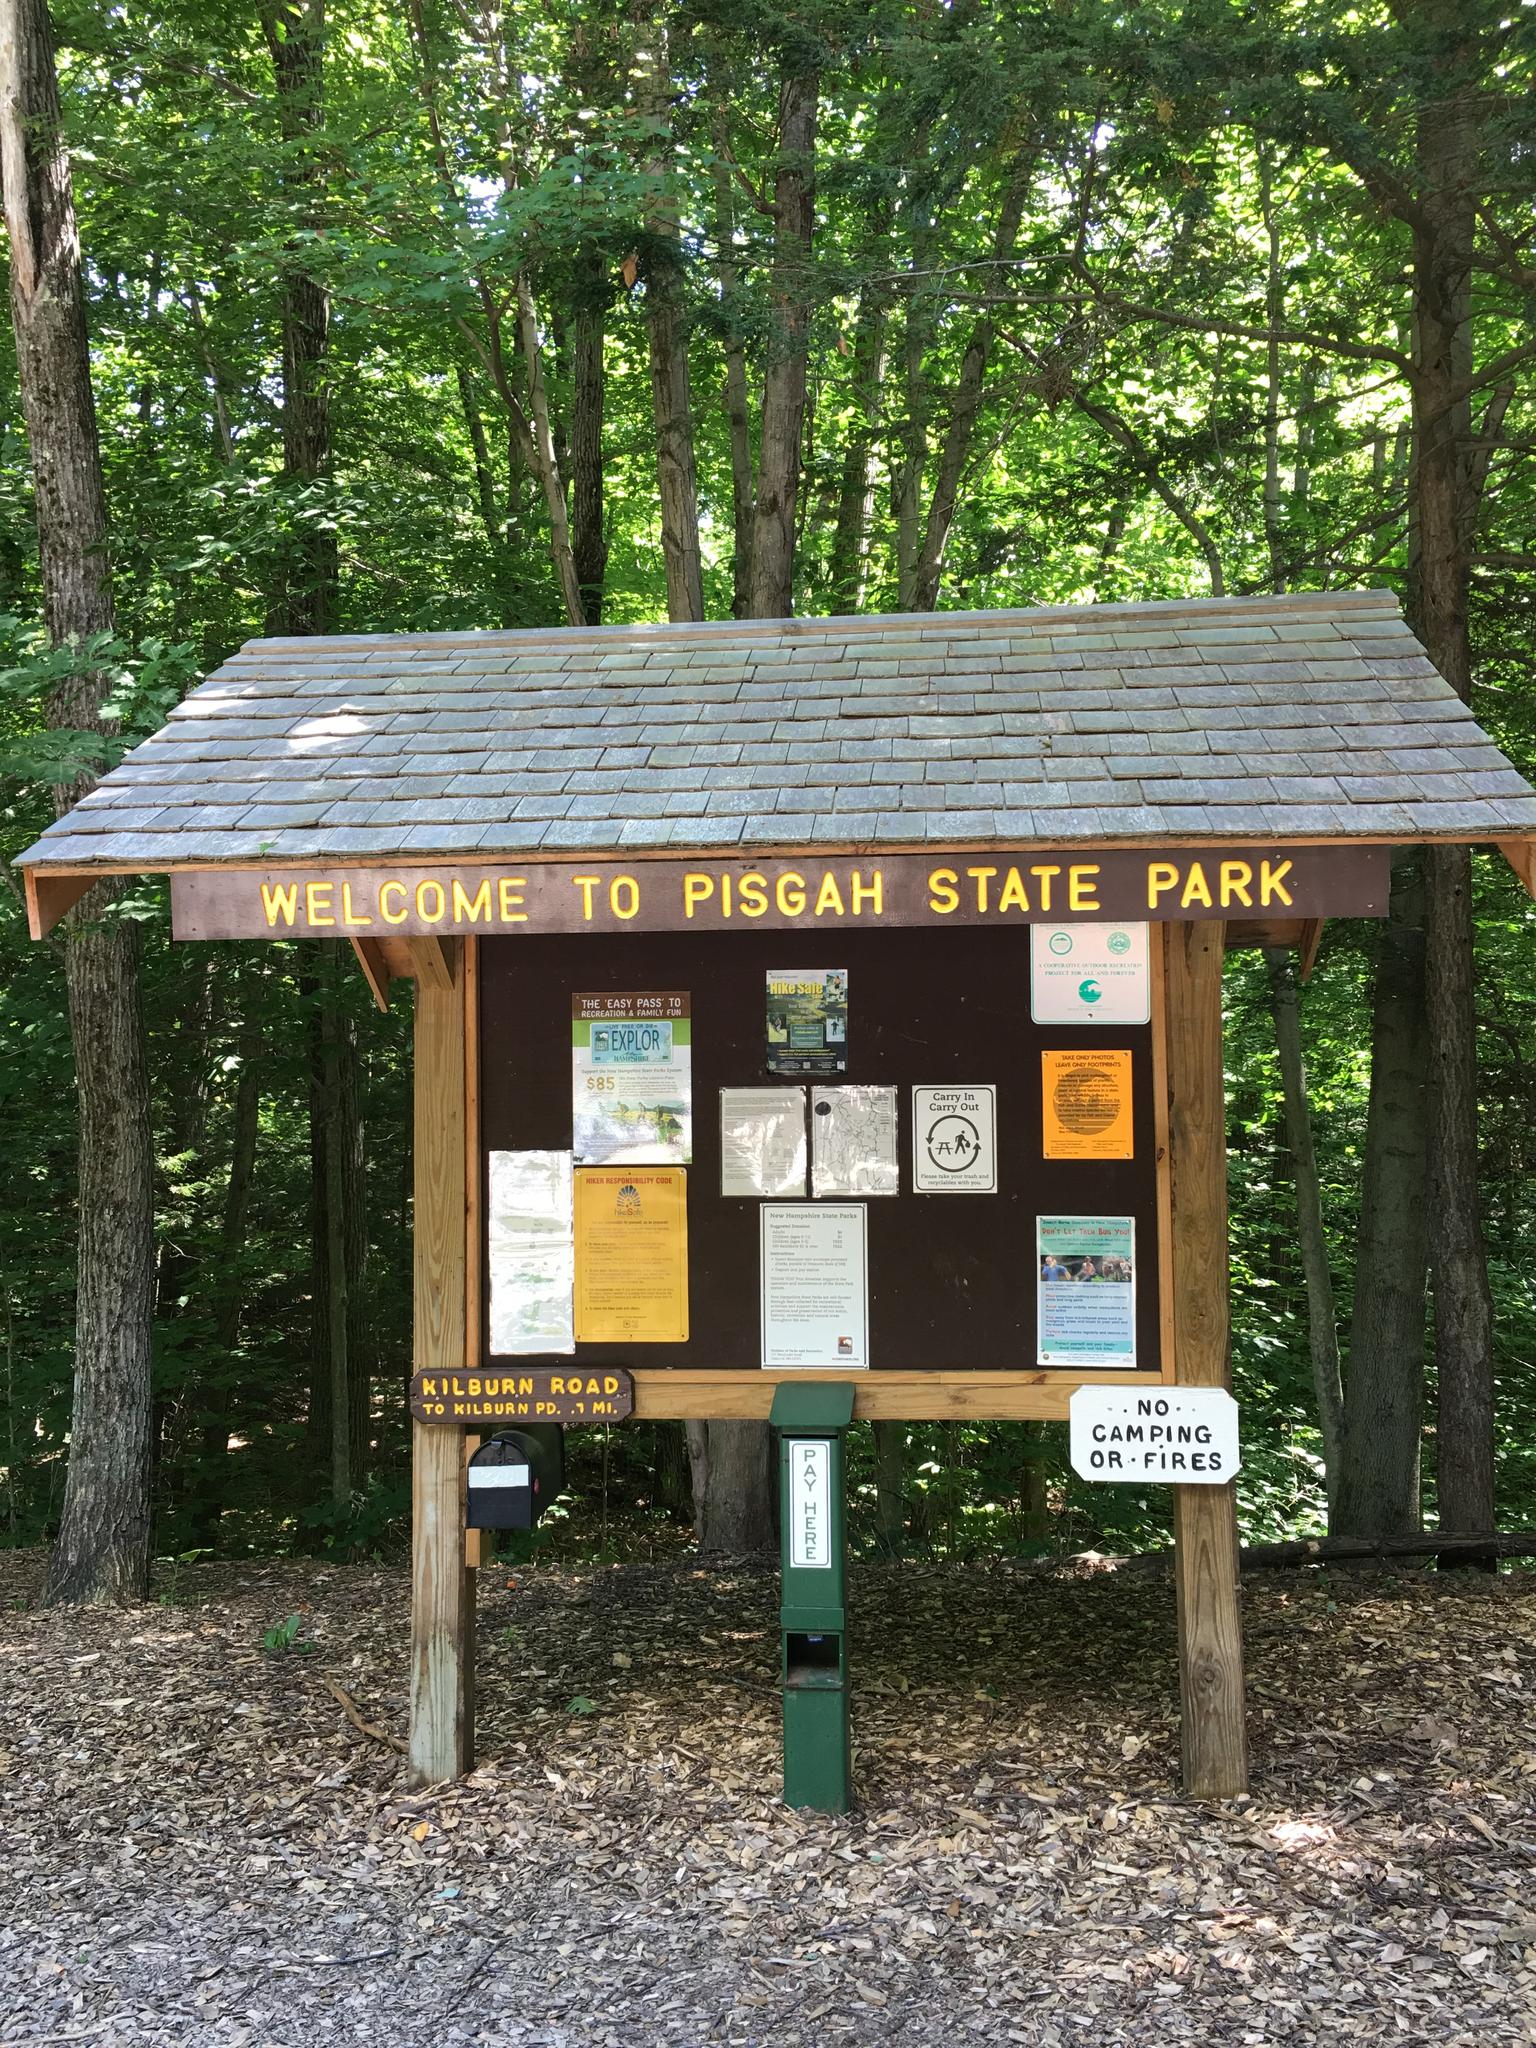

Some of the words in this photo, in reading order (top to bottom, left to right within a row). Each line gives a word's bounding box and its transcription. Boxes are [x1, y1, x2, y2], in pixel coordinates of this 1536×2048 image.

[261, 877, 528, 926] WELCOME
[573, 874, 640, 921] TO
[684, 869, 883, 918] PISGAH
[928, 863, 1101, 914] STATE
[1148, 860, 1293, 909] PARK
[770, 982, 796, 994] Hike
[797, 981, 823, 994] Safe
[582, 999, 600, 1009] THE
[605, 998, 632, 1009] 'EASY
[637, 998, 664, 1008] PASS'
[669, 998, 681, 1007] TO
[581, 1009, 626, 1018] RECREATION
[637, 1008, 664, 1017] FAMILY
[667, 1008, 681, 1016] FUN
[611, 1029, 660, 1051] EXPLOR
[587, 1076, 615, 1090] $85
[933, 1092, 961, 1103] Carry
[964, 1093, 975, 1101] In
[929, 1103, 957, 1113] Carry
[960, 1102, 979, 1111] Out
[606, 1177, 654, 1185] RESPONSIBILITY
[422, 1377, 534, 1396] KILBURN
[551, 1376, 619, 1395] ROAD
[422, 1403, 445, 1415] TO
[454, 1402, 529, 1415] KILBURN
[535, 1402, 561, 1415] PD.
[592, 1402, 617, 1414] MI.
[1138, 1399, 1169, 1416] NO
[1092, 1424, 1212, 1444] CAMPING
[1090, 1450, 1123, 1469] OR
[1144, 1452, 1222, 1471] FIRES
[804, 1449, 817, 1492] PAY
[804, 1502, 817, 1560] HERE
